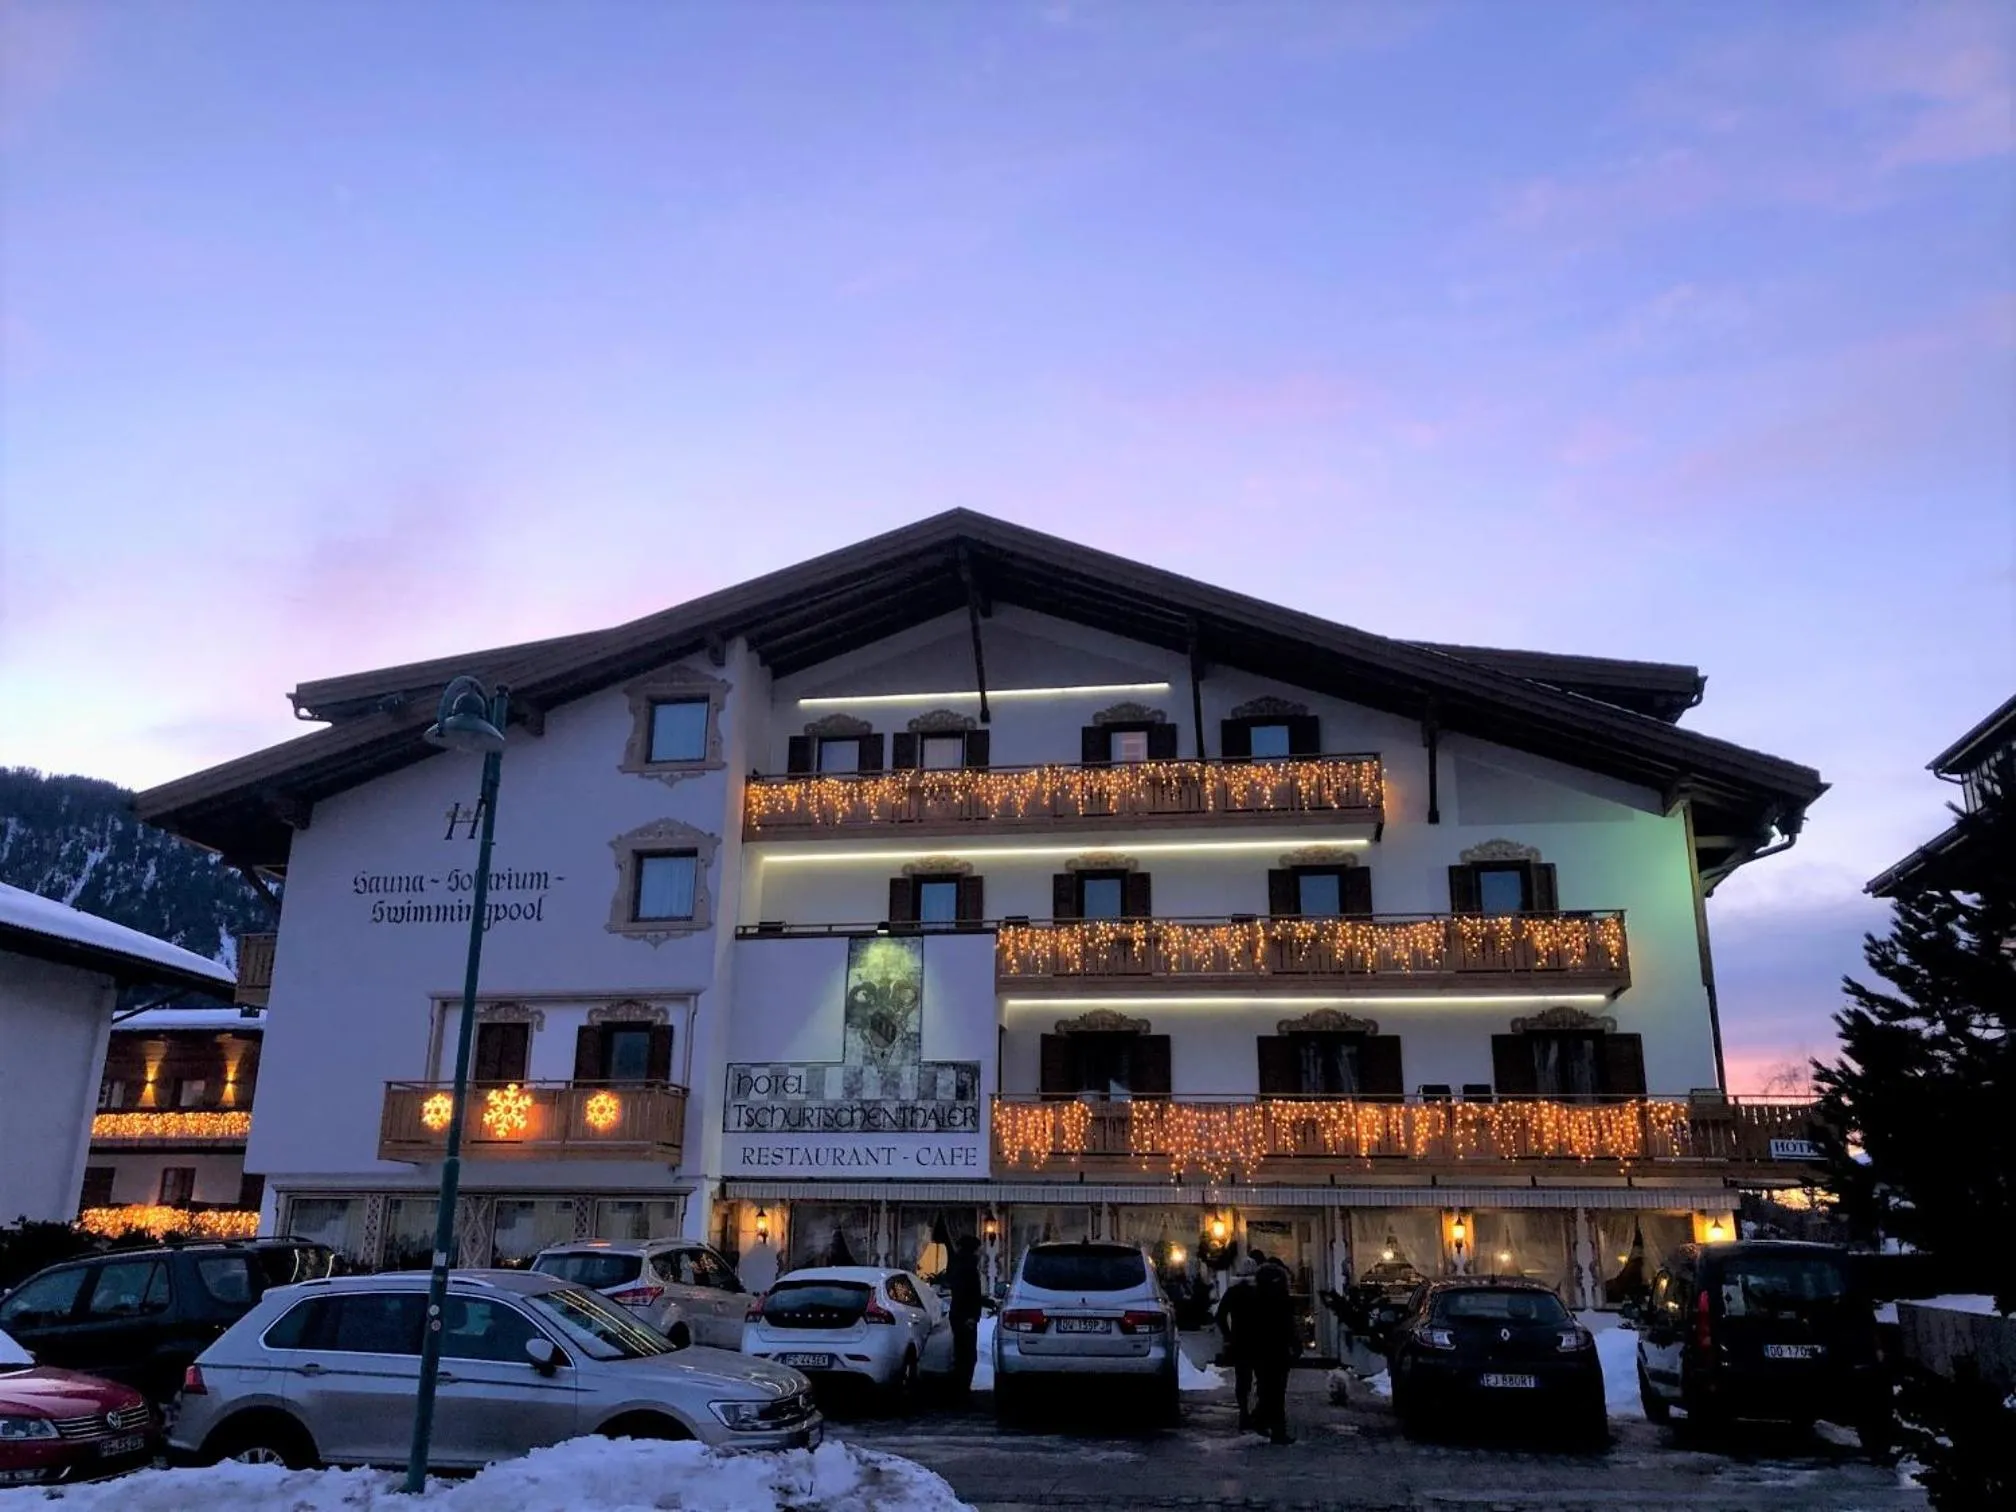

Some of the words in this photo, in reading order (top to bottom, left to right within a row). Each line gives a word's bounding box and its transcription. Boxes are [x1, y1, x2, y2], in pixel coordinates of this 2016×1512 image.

[736, 1073, 810, 1095] HOTEL
[742, 1147, 897, 1166] RESTAURANT
[916, 1147, 977, 1166] CAFE
